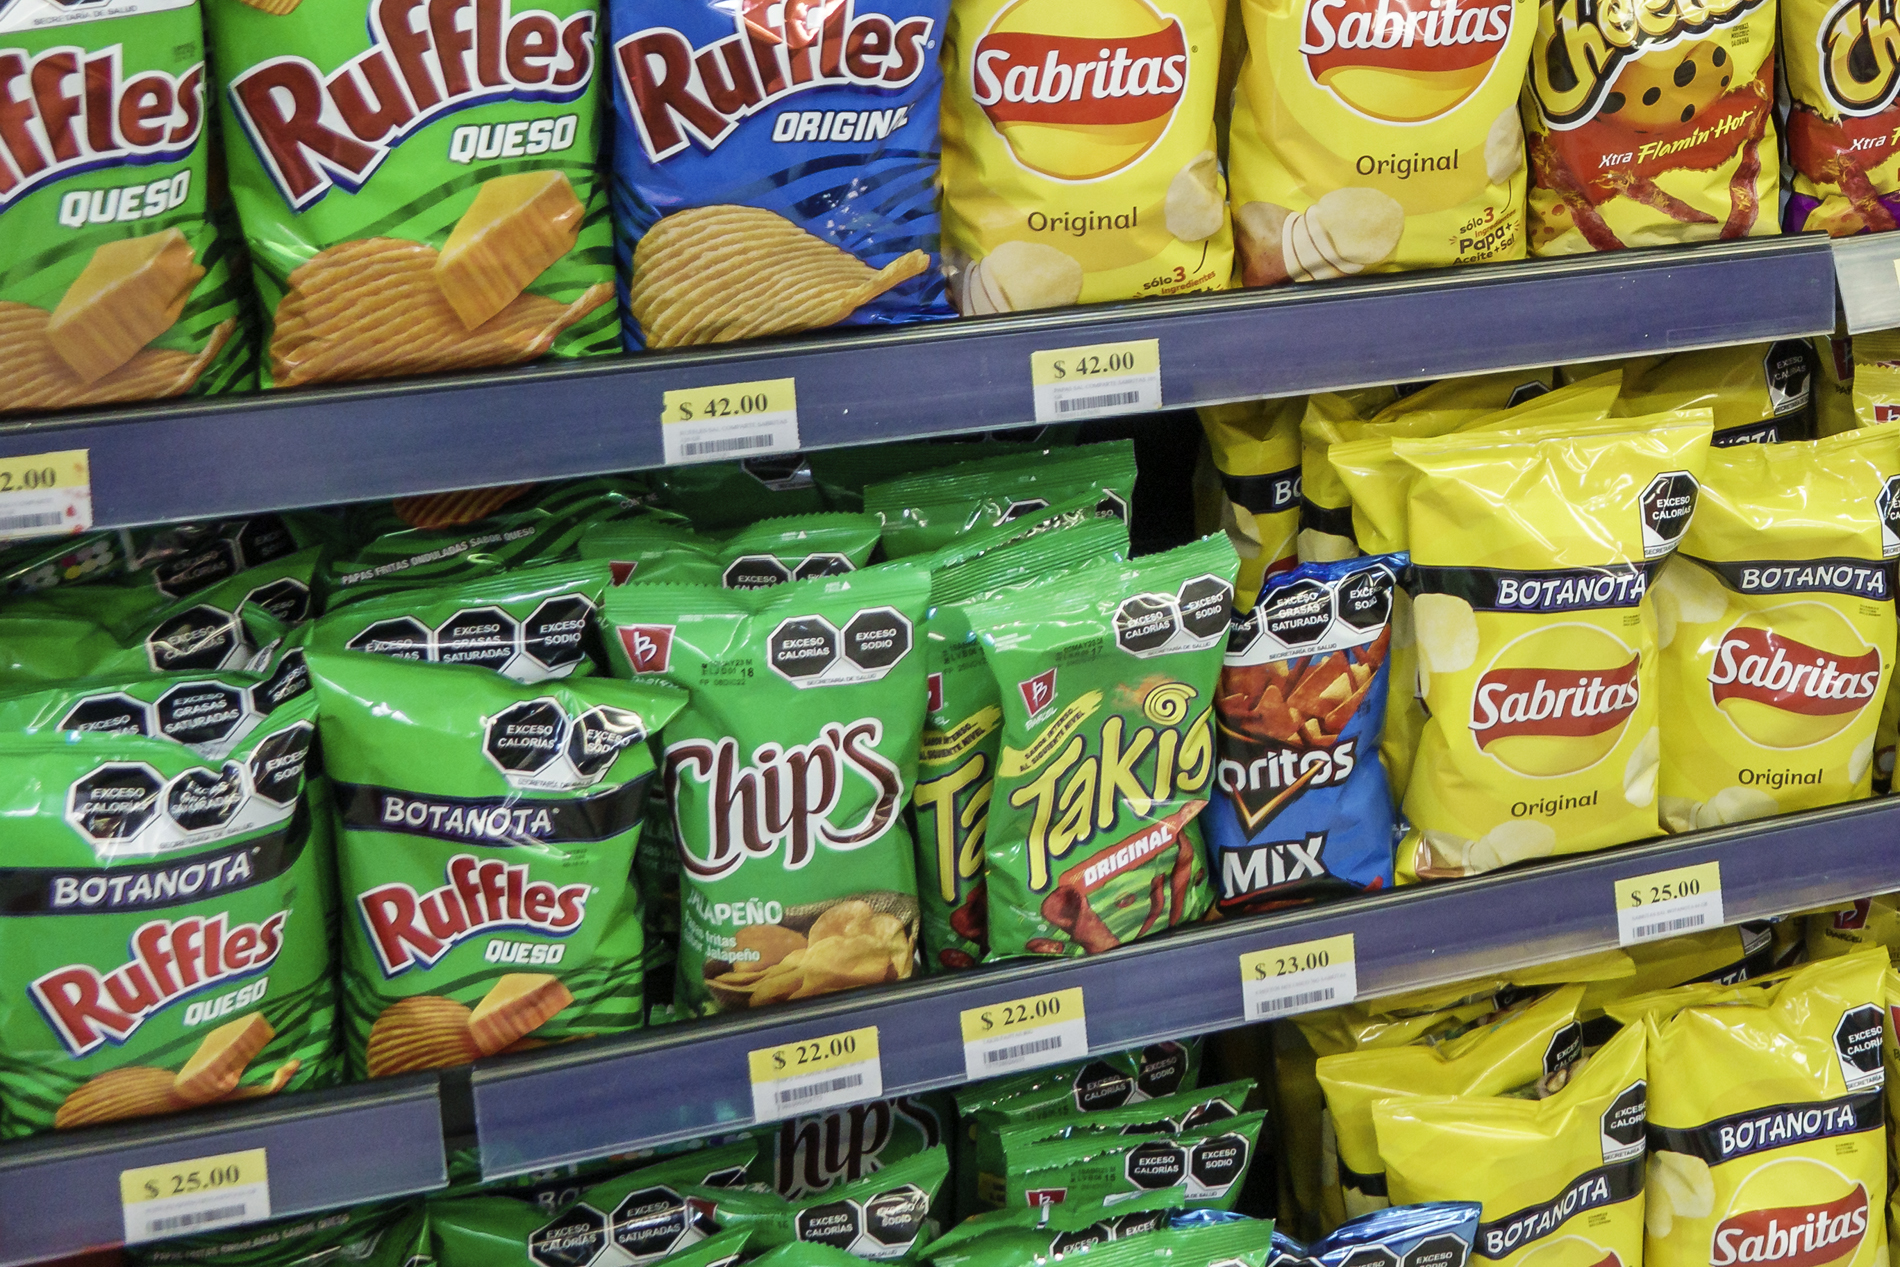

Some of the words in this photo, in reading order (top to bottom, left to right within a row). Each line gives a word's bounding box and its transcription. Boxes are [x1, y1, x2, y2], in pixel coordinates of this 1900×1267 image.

[972, 47, 1187, 104] Sabritas
[449, 116, 578, 163] QUESO
[1849, 135, 1887, 153] Xtra
[1355, 149, 1460, 180] Original
[60, 170, 191, 228] QUESO
[1027, 207, 1138, 237] Original
[1053, 361, 1066, 379] $
[1076, 352, 1134, 376] 42.00
[679, 403, 693, 421] $
[704, 394, 768, 417] 42.00
[342, 571, 373, 584] PAPAS
[375, 560, 407, 577] FRITAS
[409, 542, 467, 569] ONDULADAS
[469, 533, 501, 551] SABOR
[502, 526, 536, 542] QUESO
[1500, 572, 1648, 608] BOTANOTA
[1742, 559, 1884, 593] BOTANOTA
[1708, 638, 1879, 701] Sabritas
[1469, 676, 1638, 731] Sabritas
[1011, 683, 1213, 890] Takis
[1738, 767, 1823, 790] Original
[382, 799, 553, 834] BOTANOTA
[1511, 790, 1598, 821] Original
[1083, 826, 1173, 888] ORIGINAL
[52, 855, 252, 907] BOTANOTA
[1631, 891, 1642, 907] $
[1650, 879, 1700, 904] 25.00
[360, 856, 589, 974] Ruffles
[485, 939, 566, 965] QUESO
[1254, 964, 1267, 981] $
[1275, 951, 1329, 977] 23.00
[34, 913, 286, 1055] Ruffles
[184, 977, 269, 1026] QUESO
[980, 1013, 994, 1031] $
[1001, 998, 1061, 1025] 22.00
[772, 1050, 787, 1070] $
[797, 1035, 856, 1062] 22.00
[1720, 1105, 1855, 1156] BOTANOTA
[144, 1180, 160, 1199] $
[171, 1165, 240, 1194] 25.00
[1487, 1178, 1608, 1255] BOTANOTA
[1711, 1205, 1867, 1266] Sabritas
